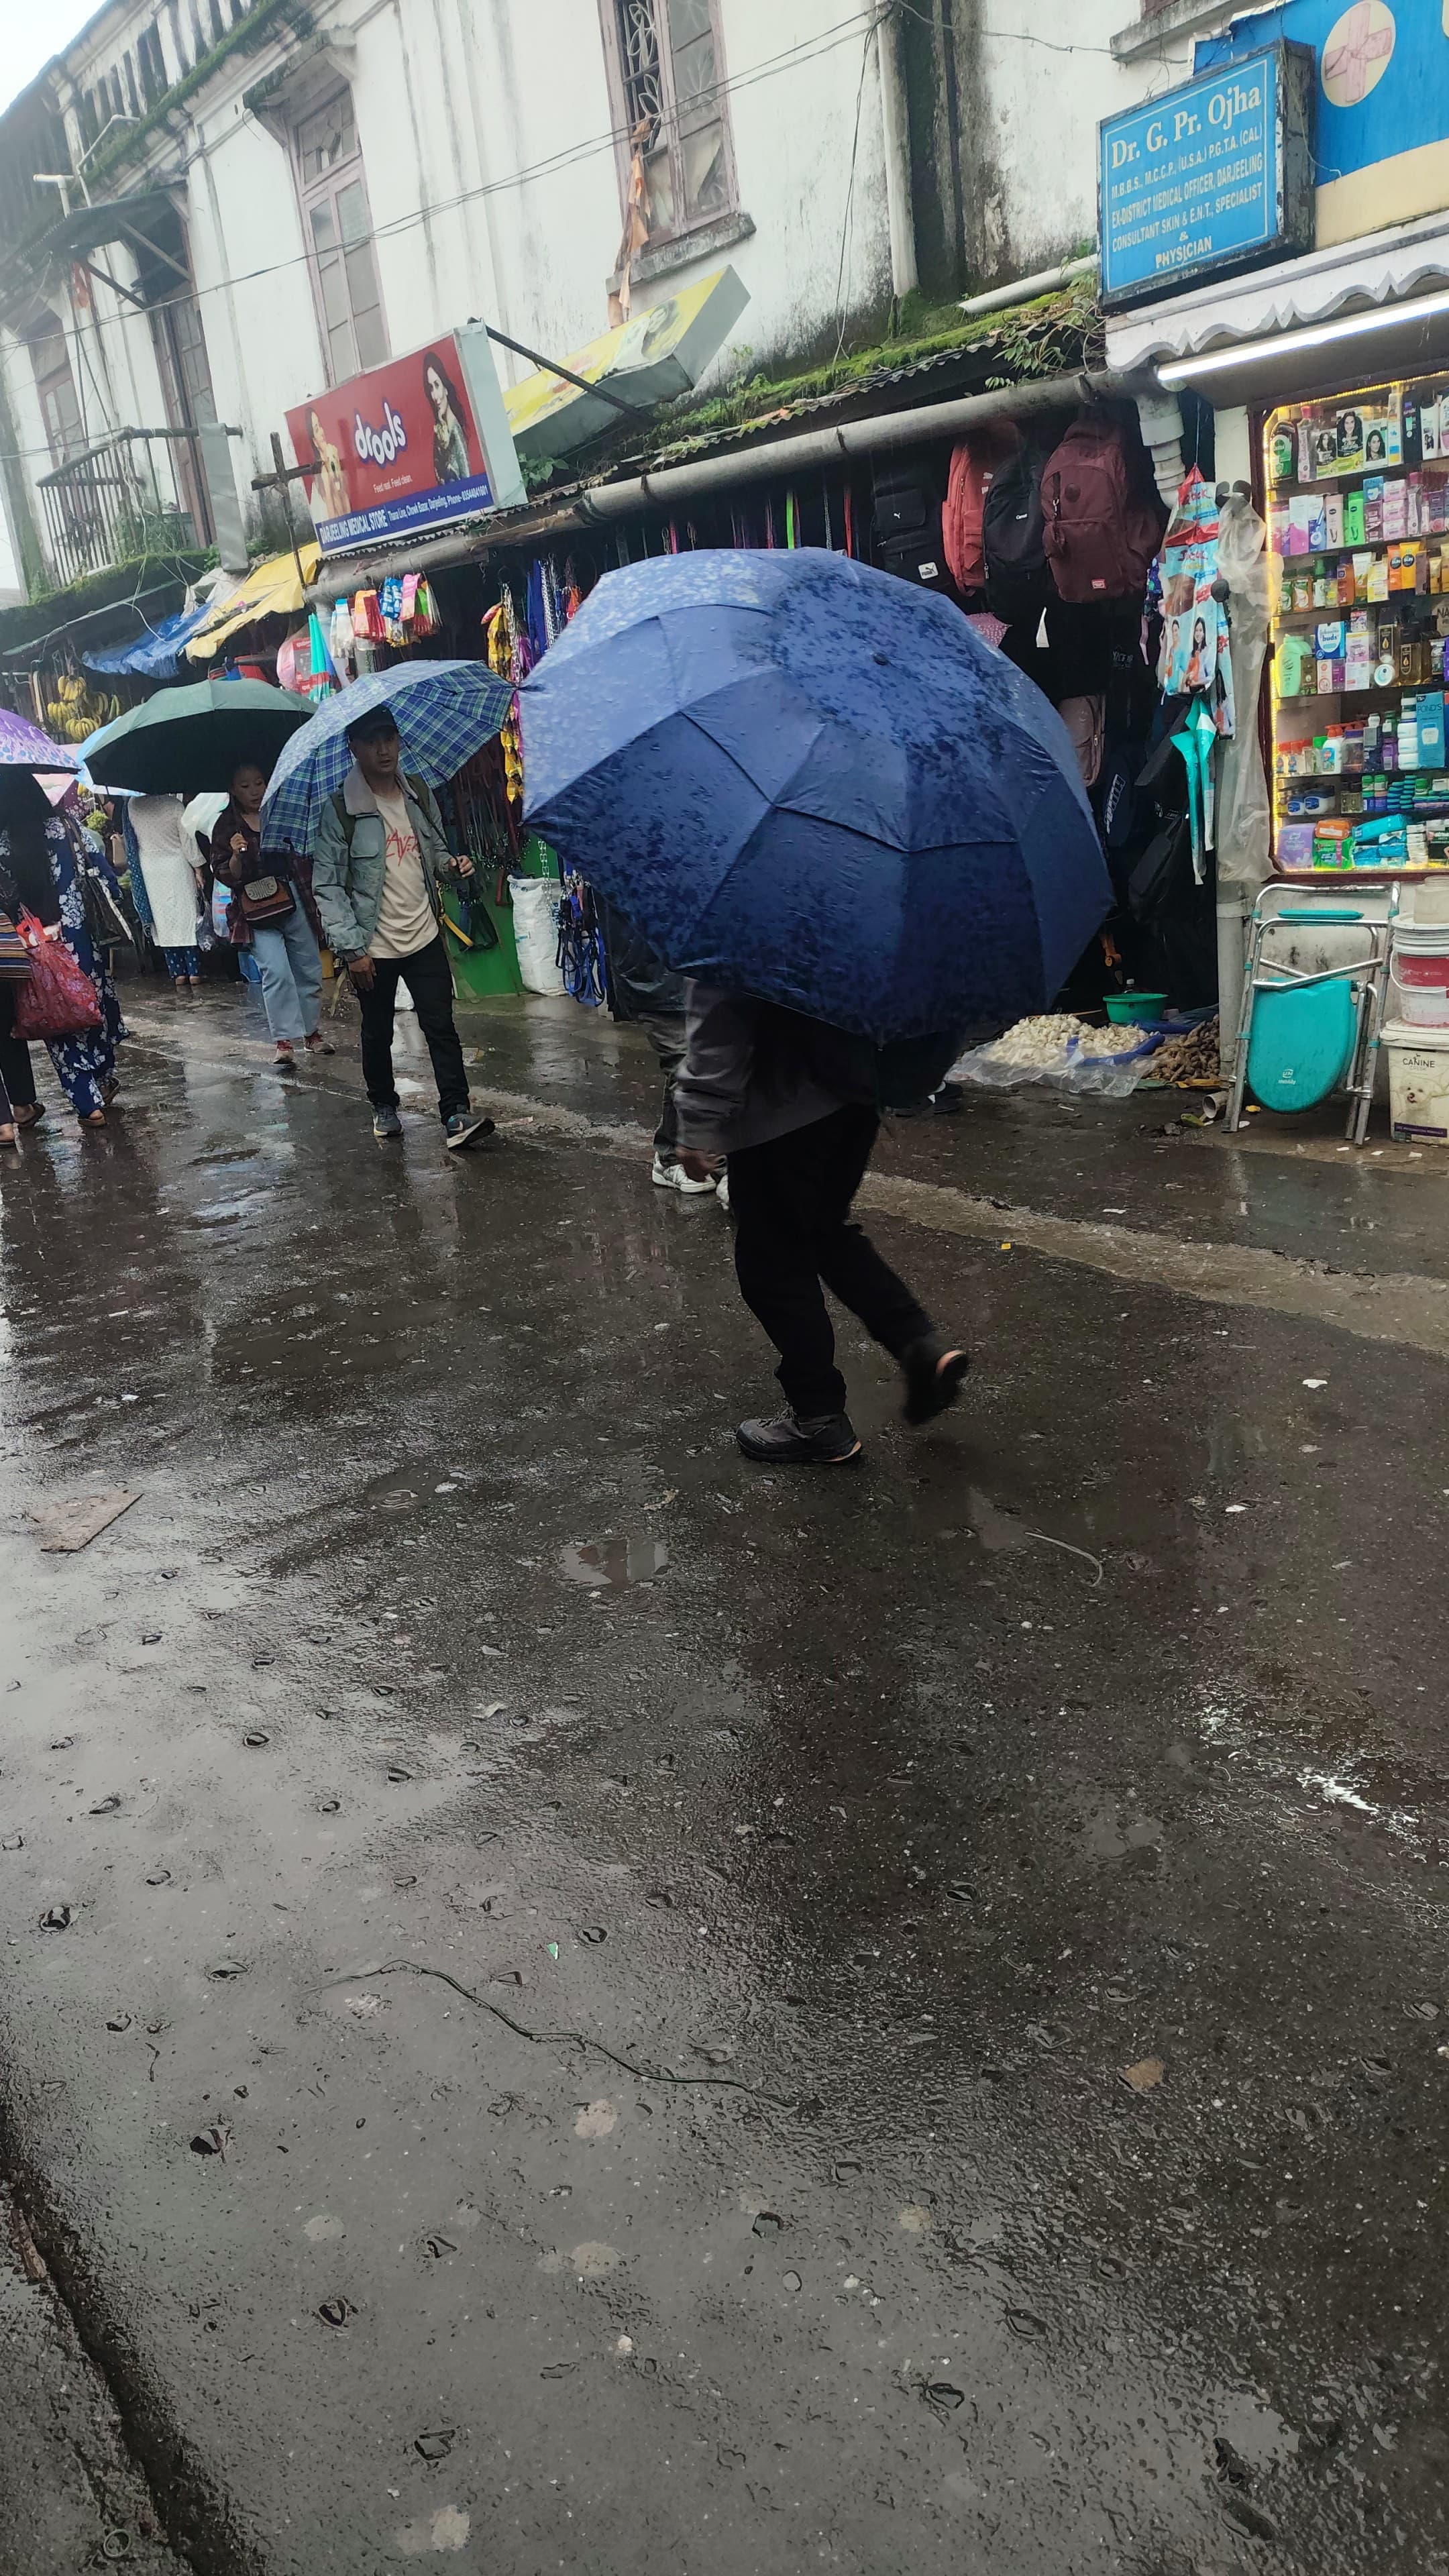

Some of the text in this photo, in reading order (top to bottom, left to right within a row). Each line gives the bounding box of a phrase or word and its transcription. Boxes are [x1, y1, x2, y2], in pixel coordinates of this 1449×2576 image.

[1112, 85, 1262, 168] Dr. G. Pr. Ojha
[1179, 145, 1208, 170] (U.S.A.)
[1209, 136, 1238, 159] P.G.T.A.
[1240, 122, 1263, 146] (CAL)
[1112, 152, 1263, 229] EX-DISTRICT MEDICAL OFFICER, DARJEELING
[1112, 221, 1161, 253] CONSULTANT
[1161, 213, 1179, 234] SKIN
[1182, 211, 1187, 226] &
[1216, 182, 1263, 214] SPECIALIST
[1179, 231, 1189, 241] &
[1155, 235, 1212, 269] PHYSICIAN
[354, 400, 407, 466] drools
[319, 509, 388, 545] DARJEELING MEDICAL STORE
[1322, 633, 1337, 641] buds
[1403, 1057, 1435, 1068] CANINE
